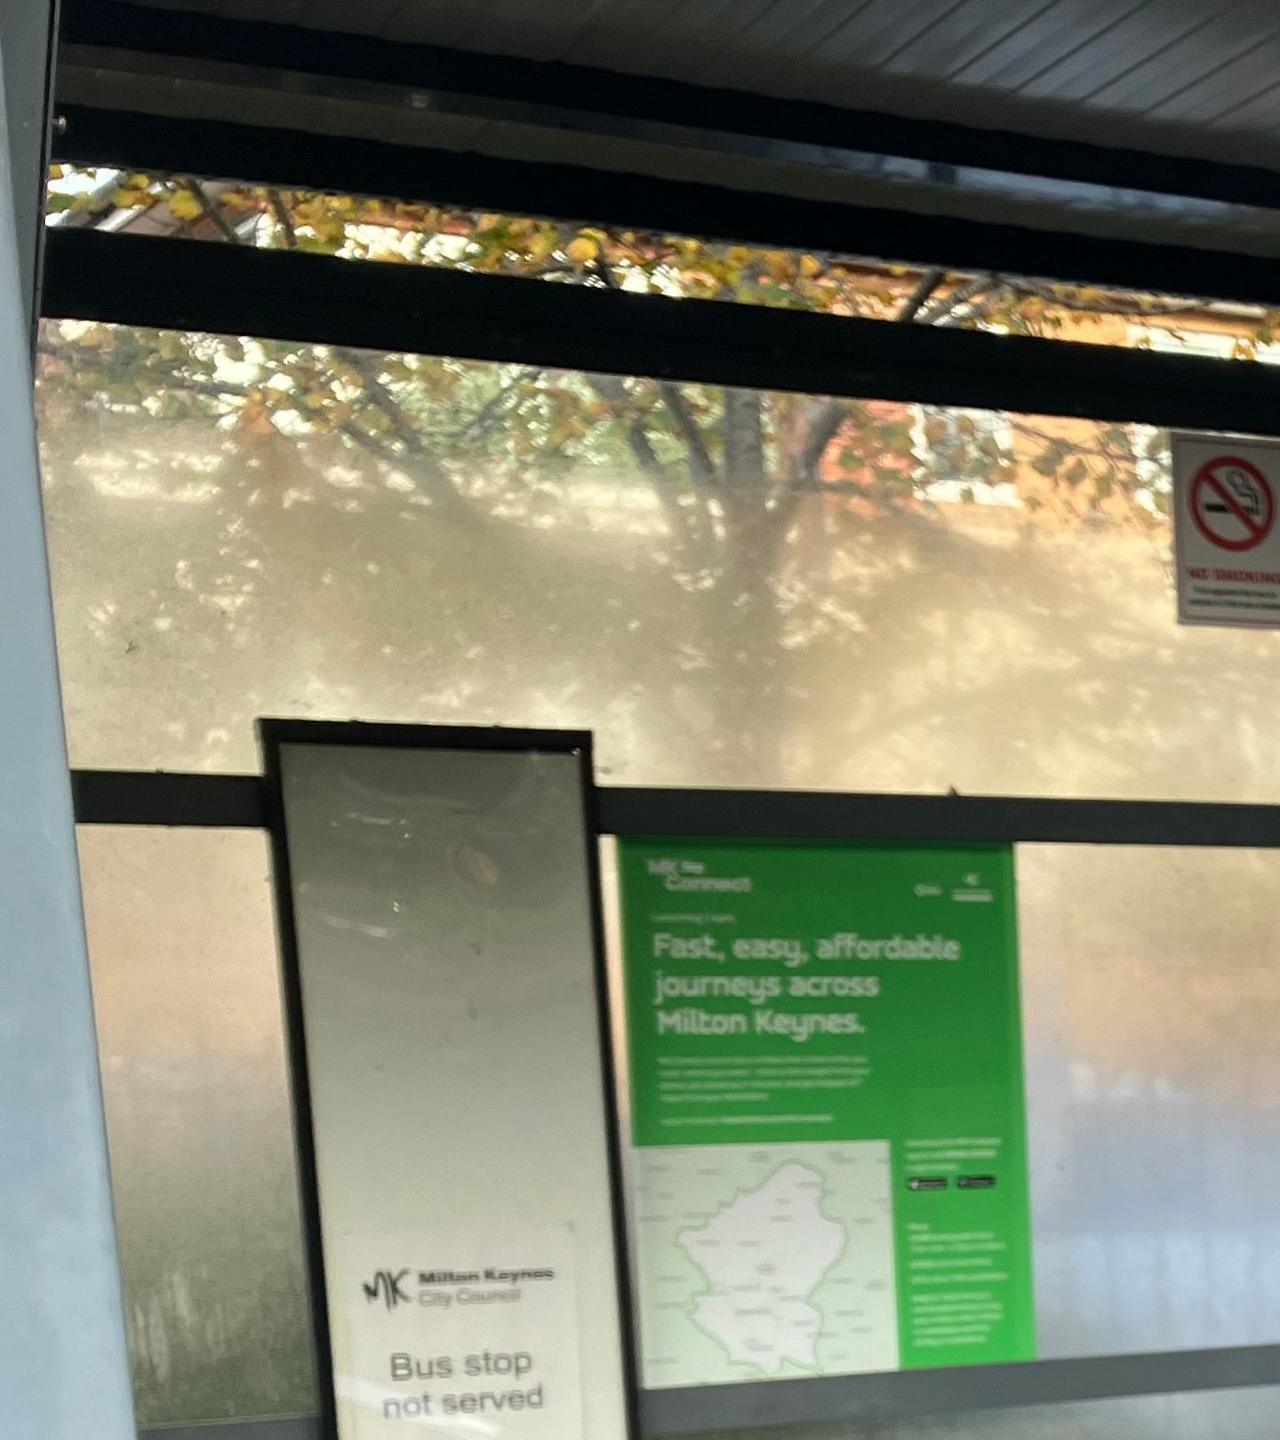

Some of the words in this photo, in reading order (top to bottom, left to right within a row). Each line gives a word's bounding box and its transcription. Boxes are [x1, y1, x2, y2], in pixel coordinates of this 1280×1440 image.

[665, 874, 752, 892] Connect
[653, 932, 725, 962] Fast,
[732, 938, 809, 967] easy,
[816, 932, 960, 961] affordable
[654, 970, 781, 1005] journeys
[788, 976, 879, 997] across
[656, 1008, 748, 1035] Milton
[755, 1010, 866, 1042] Keynes.
[418, 1270, 479, 1285] Milton
[484, 1267, 555, 1283] Keynes
[418, 1289, 450, 1308] City
[457, 1288, 521, 1305] Council
[390, 1352, 453, 1381] Bus
[464, 1351, 532, 1379] stop
[383, 1392, 431, 1419] not
[442, 1384, 543, 1415] served
